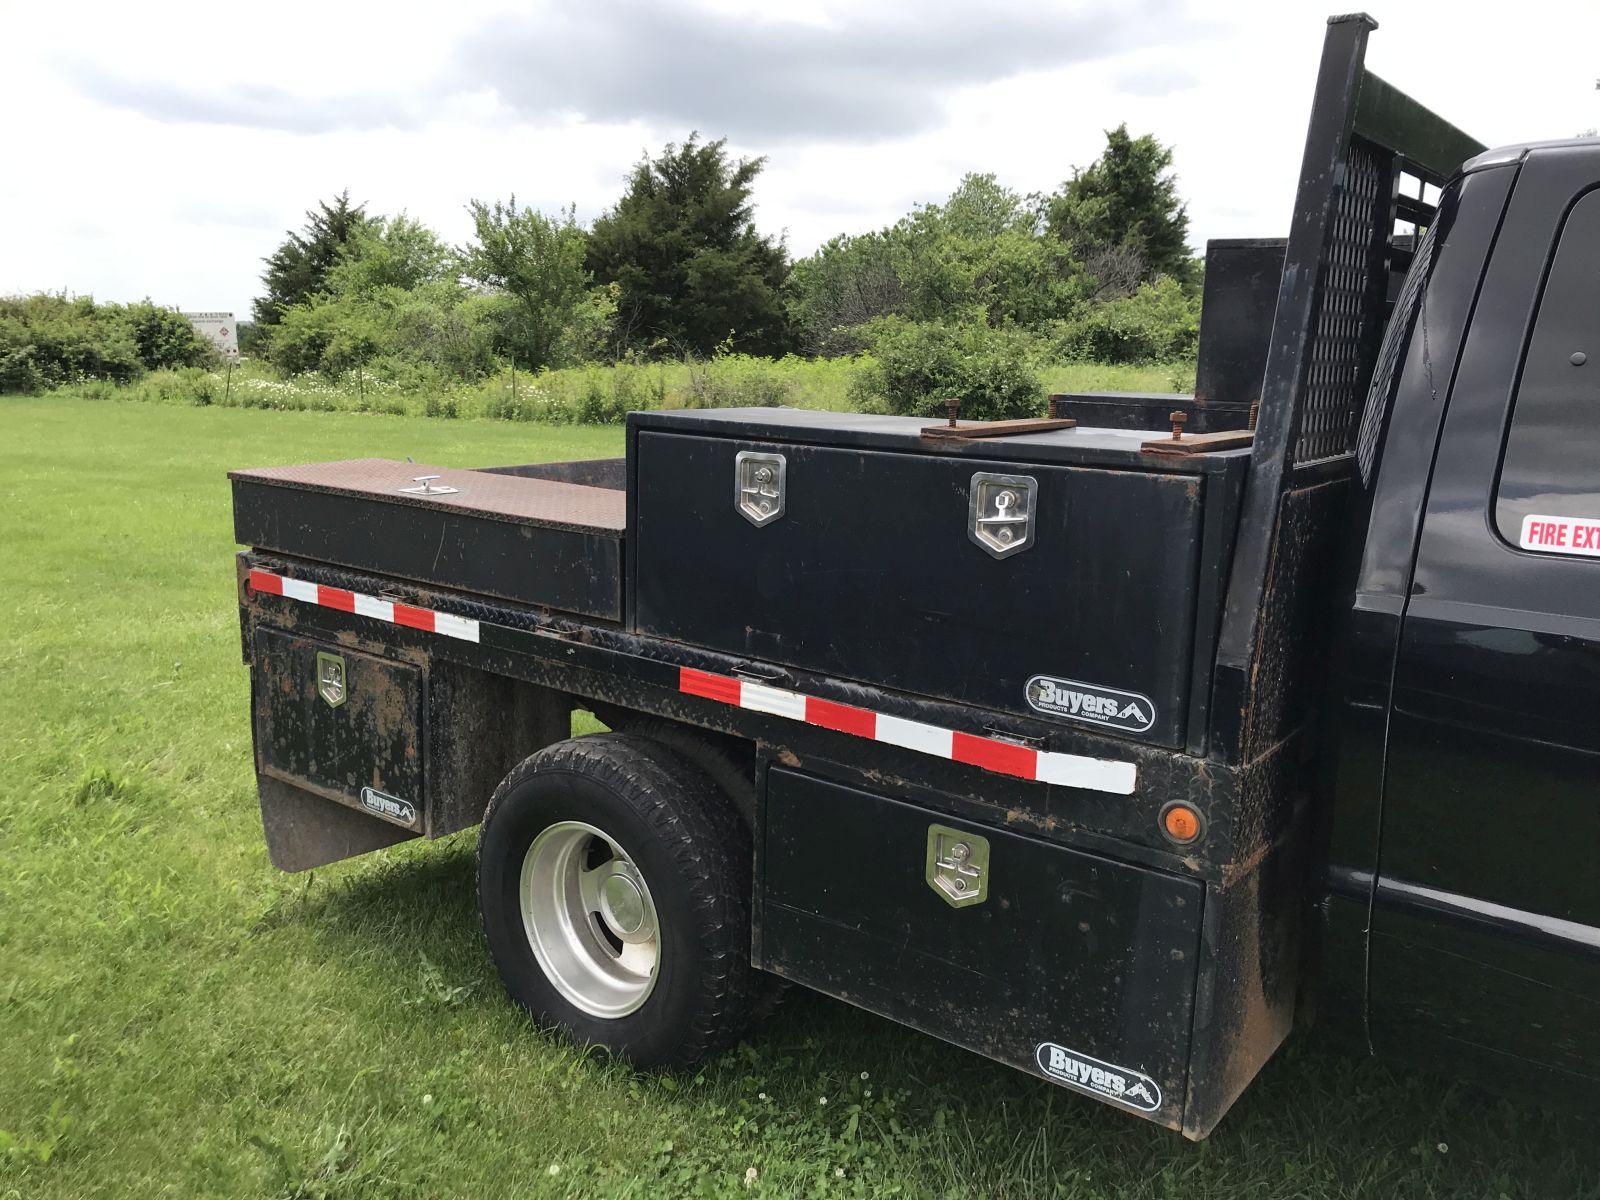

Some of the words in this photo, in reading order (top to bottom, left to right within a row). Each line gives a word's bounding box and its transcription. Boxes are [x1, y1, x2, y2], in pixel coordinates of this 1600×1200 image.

[1528, 521, 1568, 546] FIRE
[1039, 680, 1118, 717] Buyers
[1039, 702, 1067, 713] PRODUCTS
[1081, 710, 1110, 721] COMPANY
[366, 789, 400, 815] Buyers
[1049, 1046, 1126, 1093] Buyers
